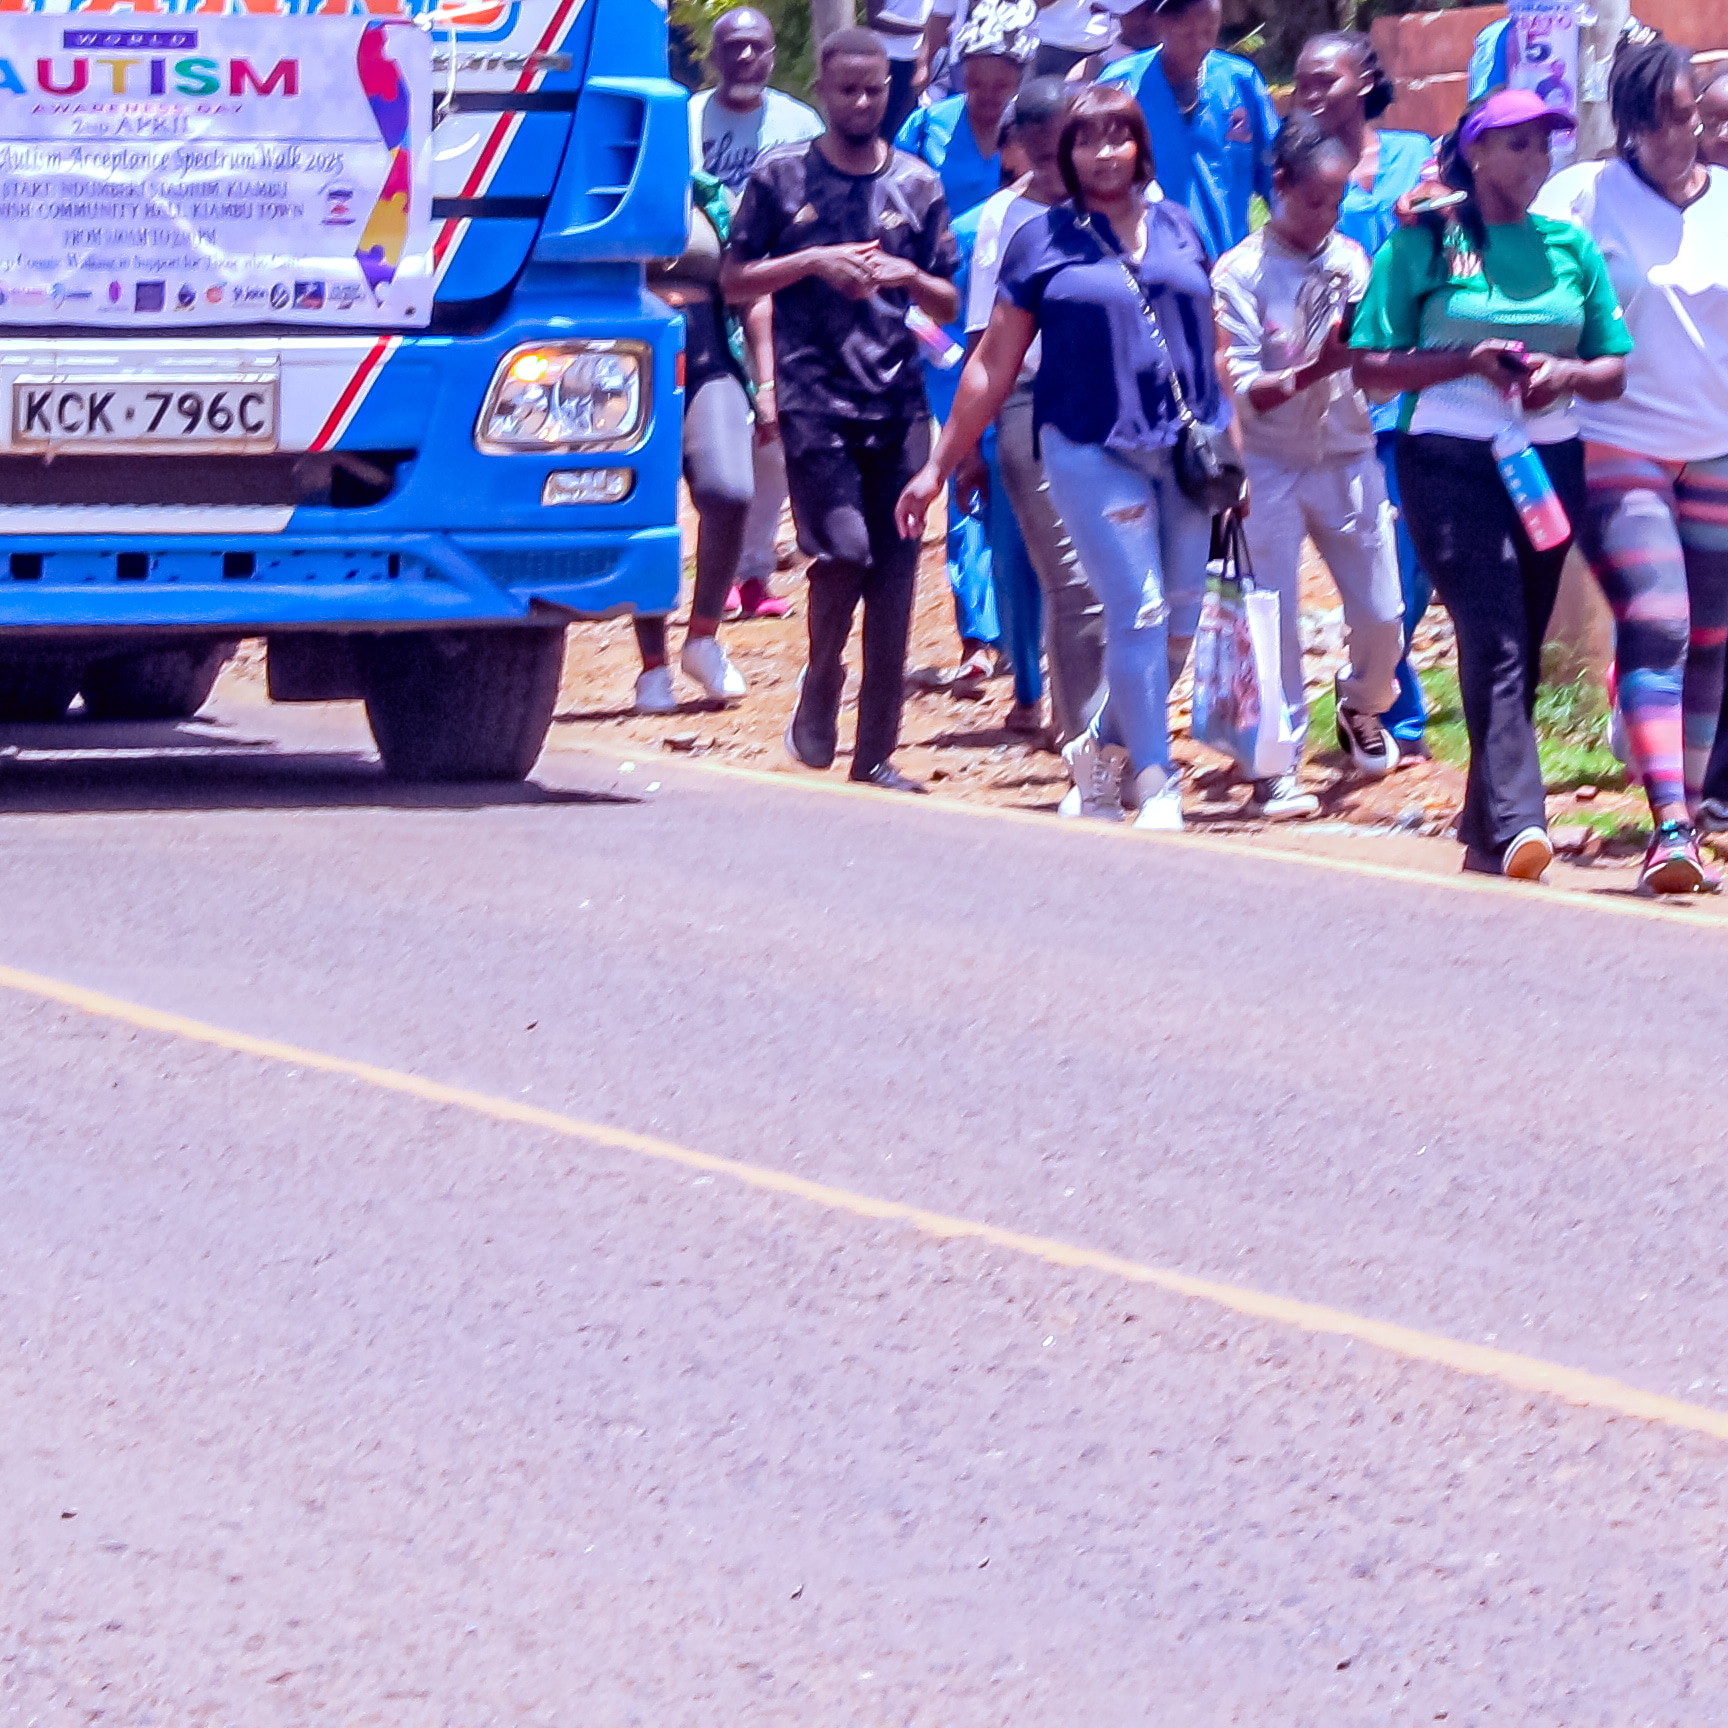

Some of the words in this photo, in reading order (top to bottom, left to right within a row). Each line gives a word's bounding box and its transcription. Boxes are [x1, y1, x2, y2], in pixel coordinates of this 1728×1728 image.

[196, 103, 244, 114] DAY
[62, 145, 173, 180] Acceptance
[176, 145, 256, 180] Spectrum
[257, 143, 302, 170] Walk
[307, 152, 344, 175] 2025
[25, 390, 117, 434] KCK
[144, 390, 266, 435] 796C
